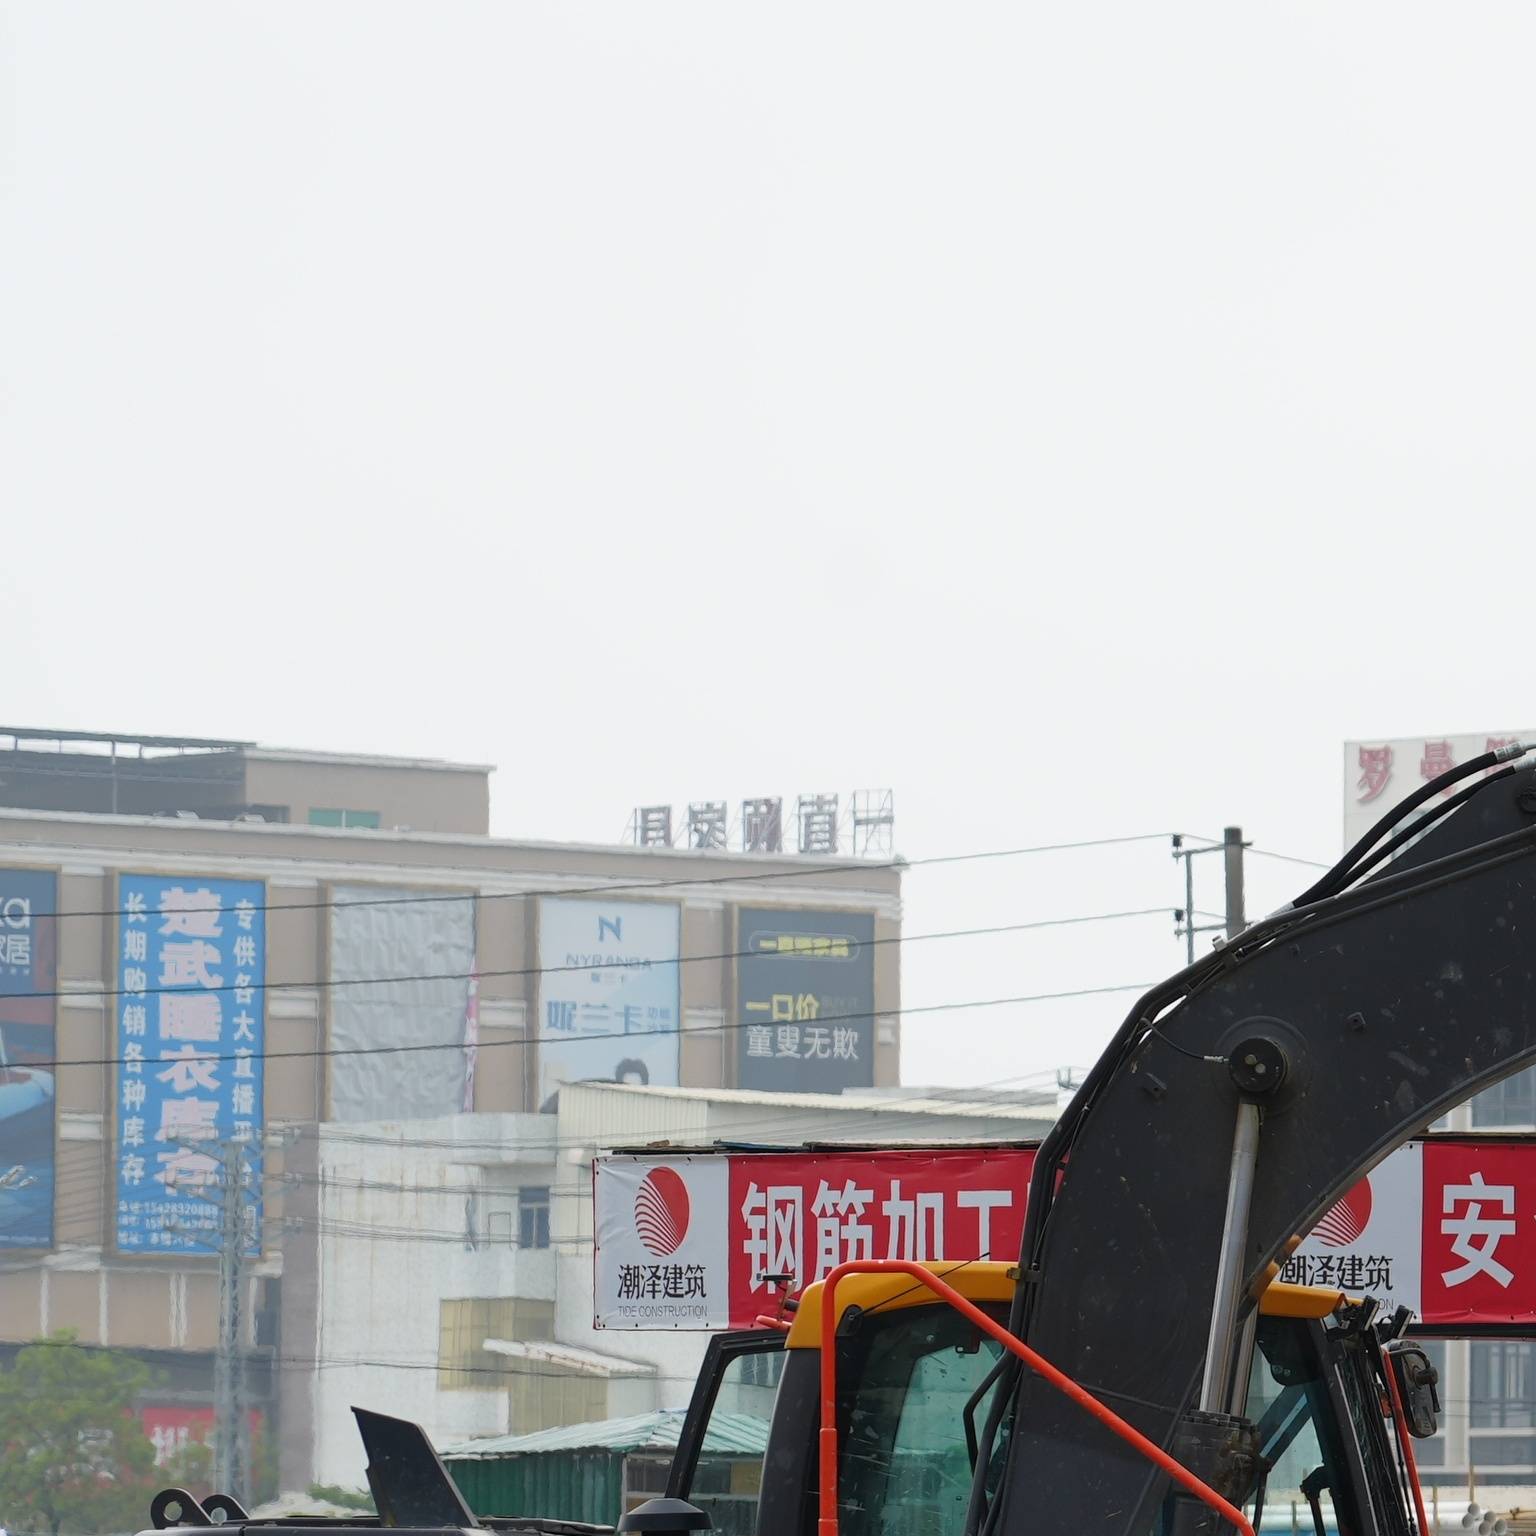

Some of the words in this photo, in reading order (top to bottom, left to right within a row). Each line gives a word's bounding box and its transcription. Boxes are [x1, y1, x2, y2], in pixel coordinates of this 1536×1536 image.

[746, 993, 820, 1021] 一口价
[746, 1025, 859, 1060] 童叟无欺
[617, 1264, 707, 1300] 潮泽建筑
[618, 1305, 637, 1318] TIDE
[640, 1304, 708, 1320] CONSTRUCTION
